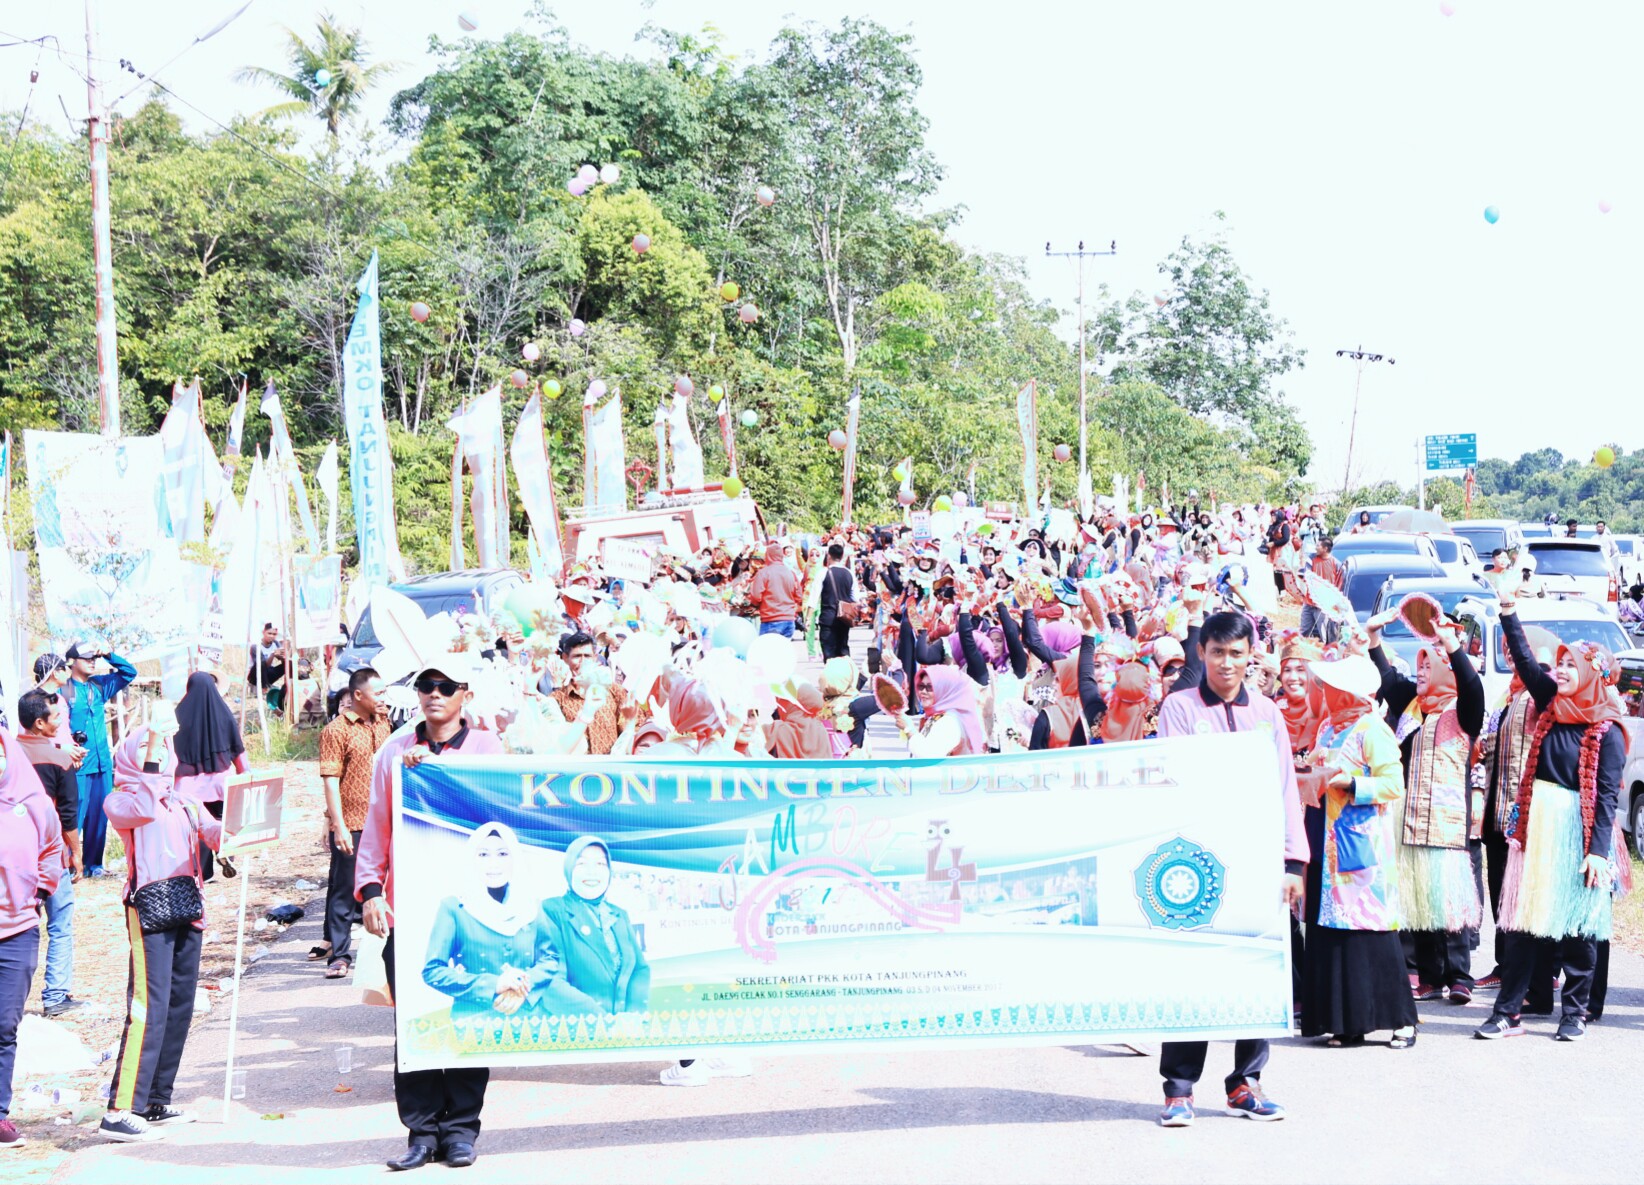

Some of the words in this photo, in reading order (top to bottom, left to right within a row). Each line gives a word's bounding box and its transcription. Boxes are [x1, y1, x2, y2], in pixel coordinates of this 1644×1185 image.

[518, 767, 912, 808] KONTINGEN
[939, 757, 1179, 795] DEFILE
[241, 785, 269, 827] PKK
[718, 803, 917, 911] JAMBORE
[714, 991, 739, 1001] DAENG
[740, 990, 766, 1000] CELAK
[767, 990, 783, 999] NO.1
[785, 987, 836, 998] SENGGARANG
[842, 985, 902, 996] TANJUNGPINANG
[943, 983, 981, 992] NOVEMBER
[735, 974, 814, 986] SEKRETARIAT
[817, 974, 839, 983] PKK
[842, 972, 872, 982] KOTA
[876, 970, 967, 981] TANJUNGPINANG
